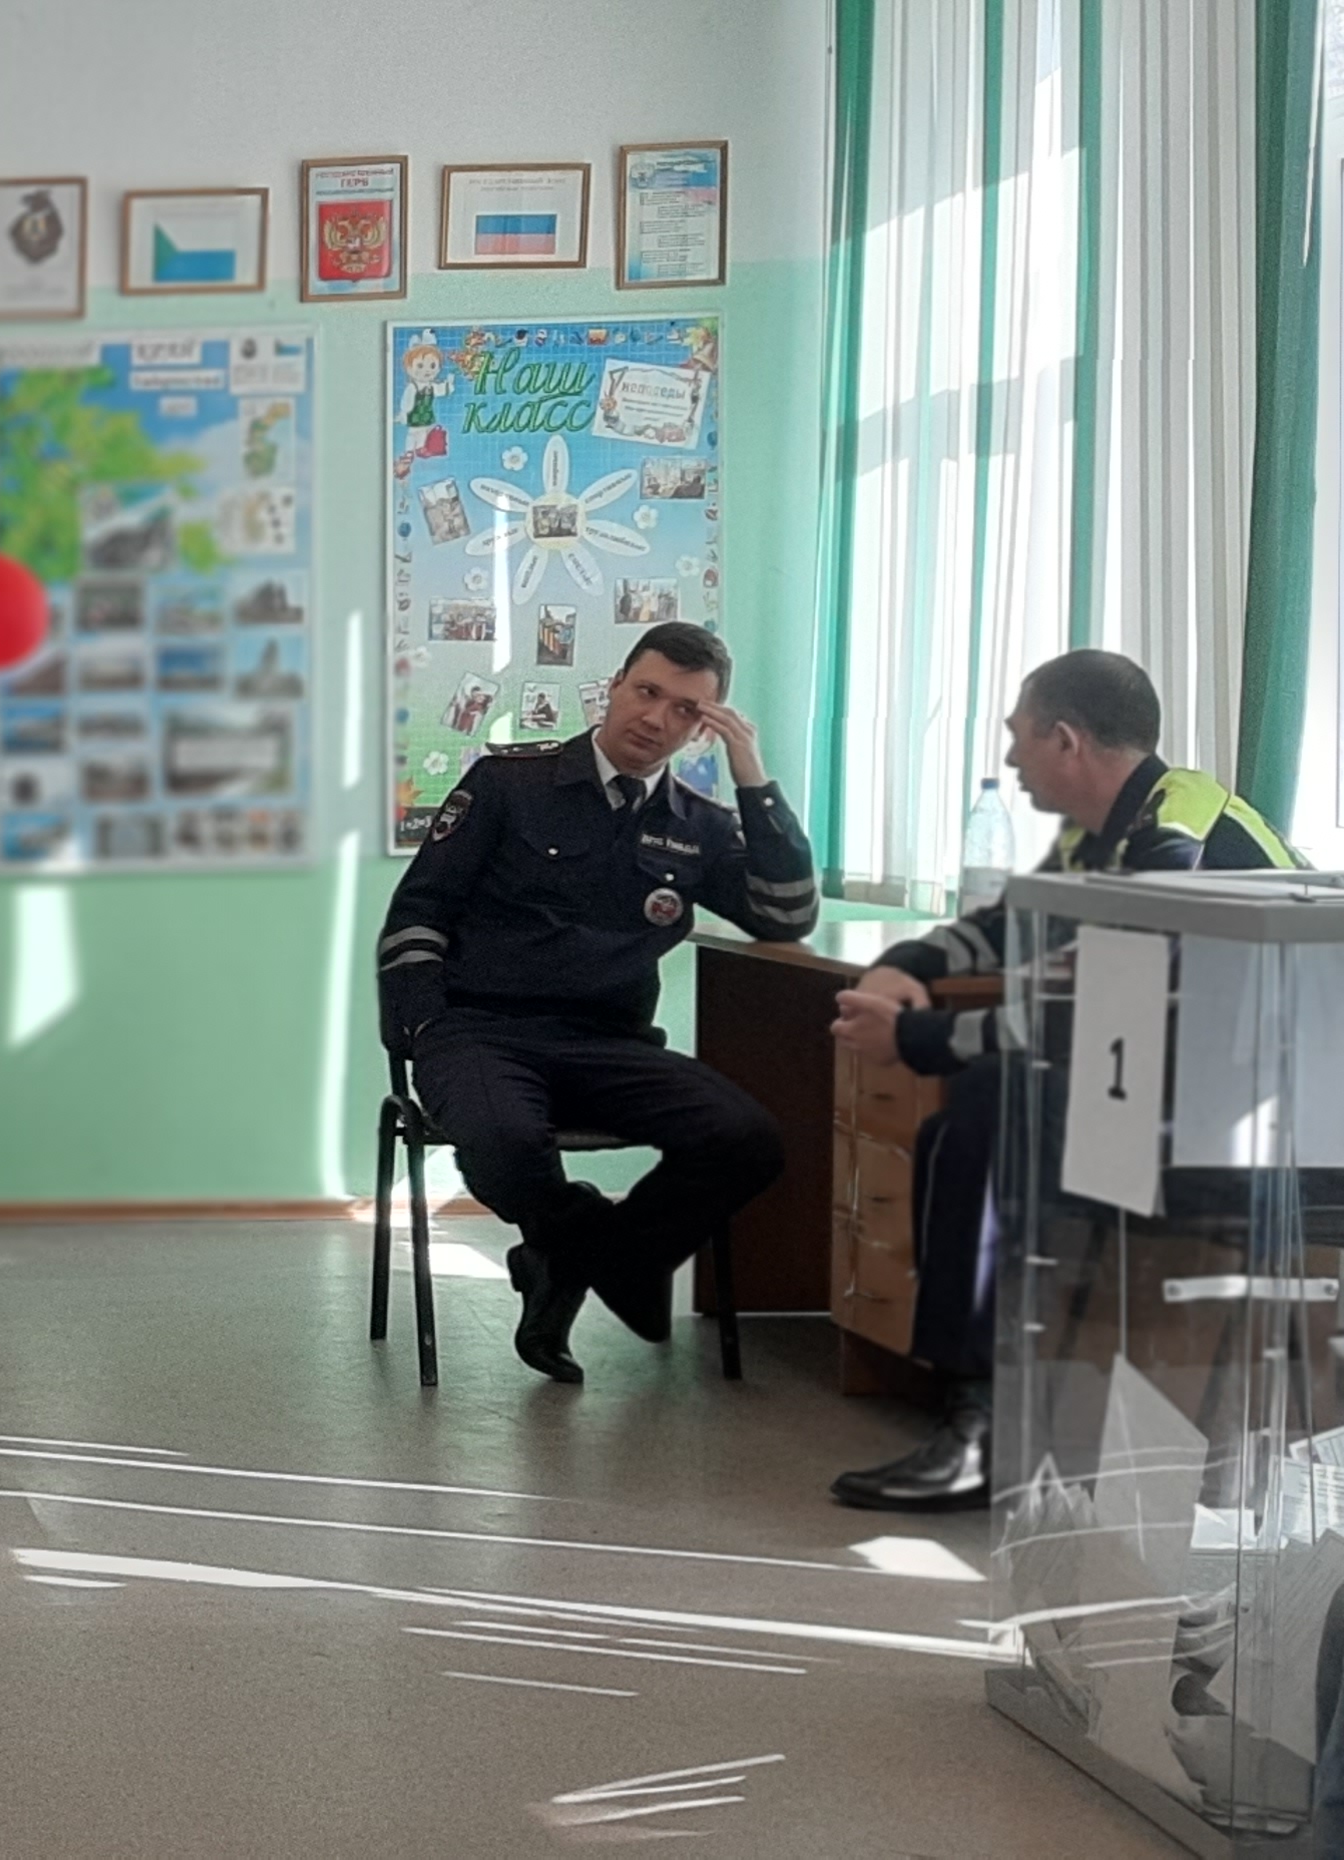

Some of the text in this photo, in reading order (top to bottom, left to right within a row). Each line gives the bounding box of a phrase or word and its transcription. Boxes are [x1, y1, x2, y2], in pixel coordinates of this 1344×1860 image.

[474, 347, 596, 396] Наш
[462, 399, 595, 434] класс
[1108, 1036, 1127, 1102] 1
